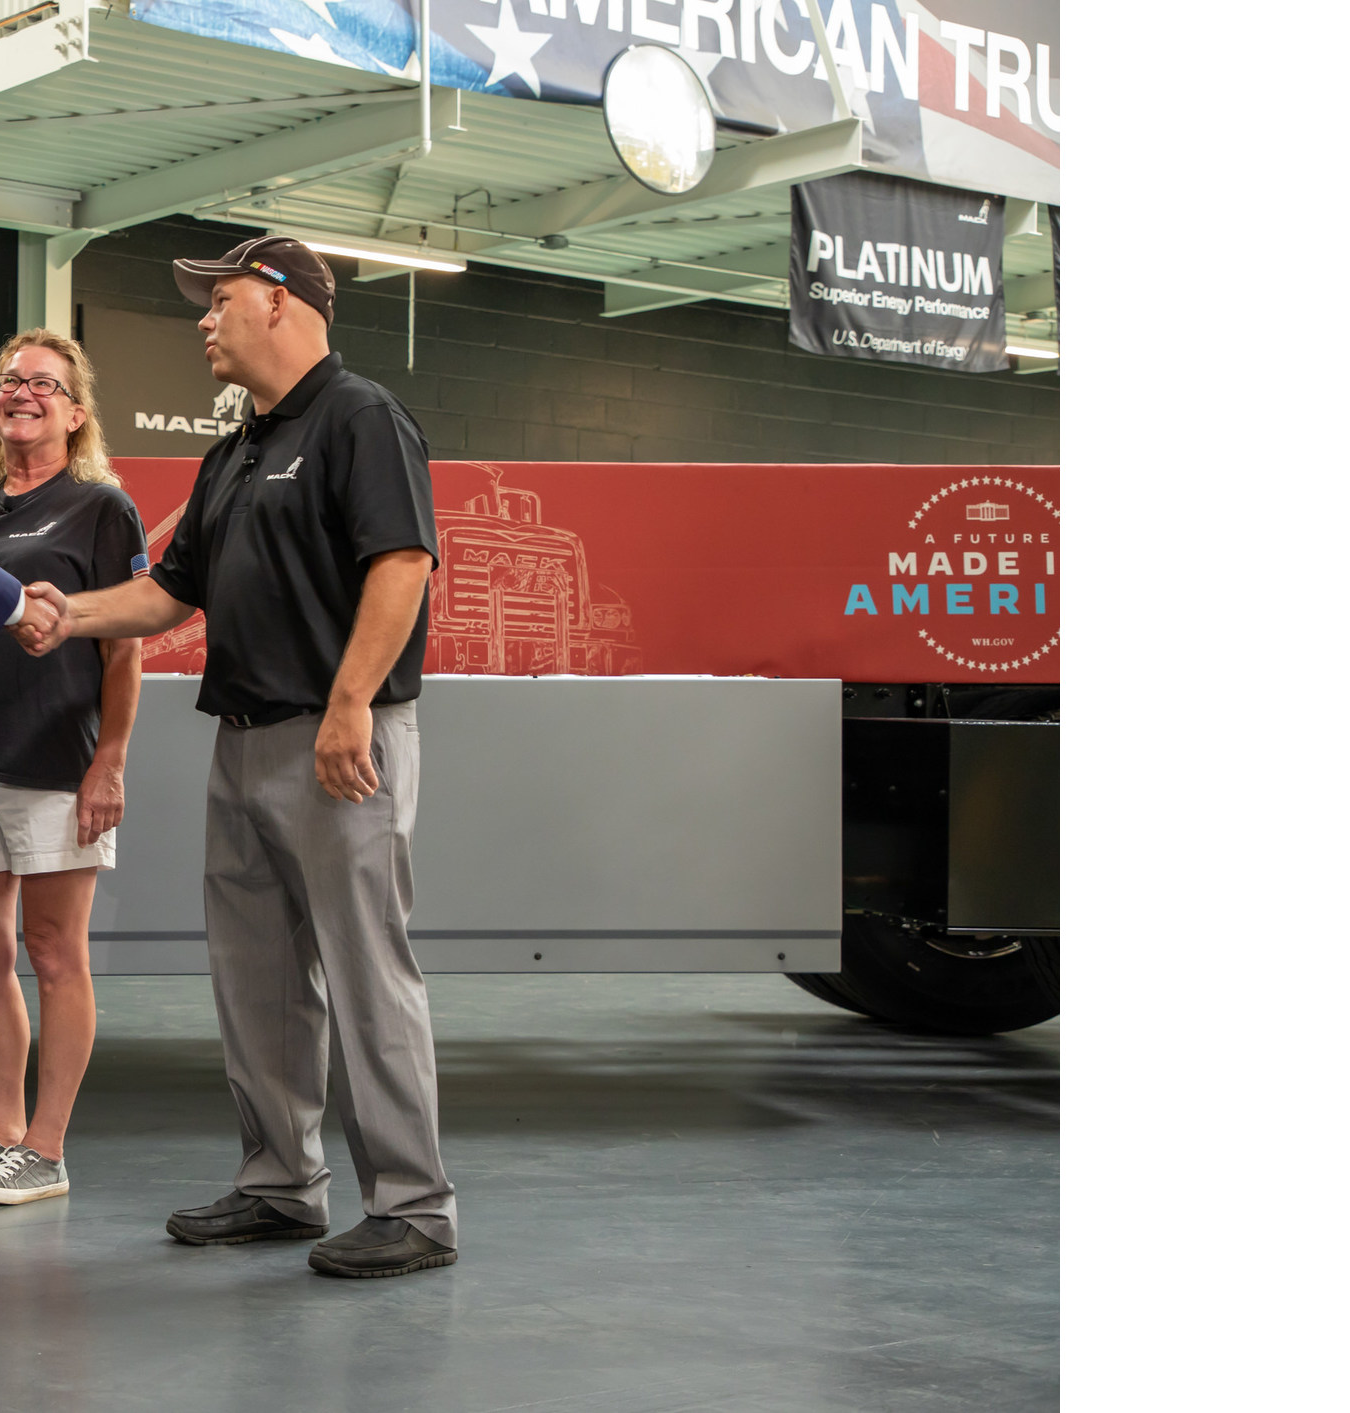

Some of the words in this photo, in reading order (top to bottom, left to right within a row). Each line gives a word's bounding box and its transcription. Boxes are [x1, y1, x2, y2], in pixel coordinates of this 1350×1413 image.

[480, 0, 919, 101] RICAN
[806, 229, 994, 296] PLATINUM
[808, 281, 871, 307] Superior
[872, 290, 913, 316] Energy
[914, 296, 990, 320] Performance
[859, 332, 922, 354] Department
[923, 340, 937, 354] of
[135, 411, 243, 437] MACK
[925, 534, 935, 544] A
[953, 533, 1050, 544] FUTURE
[463, 549, 567, 572] MACK
[888, 551, 1020, 576] MADE
[844, 583, 1046, 615] AMERI
[972, 638, 1015, 647] WH.GOV
